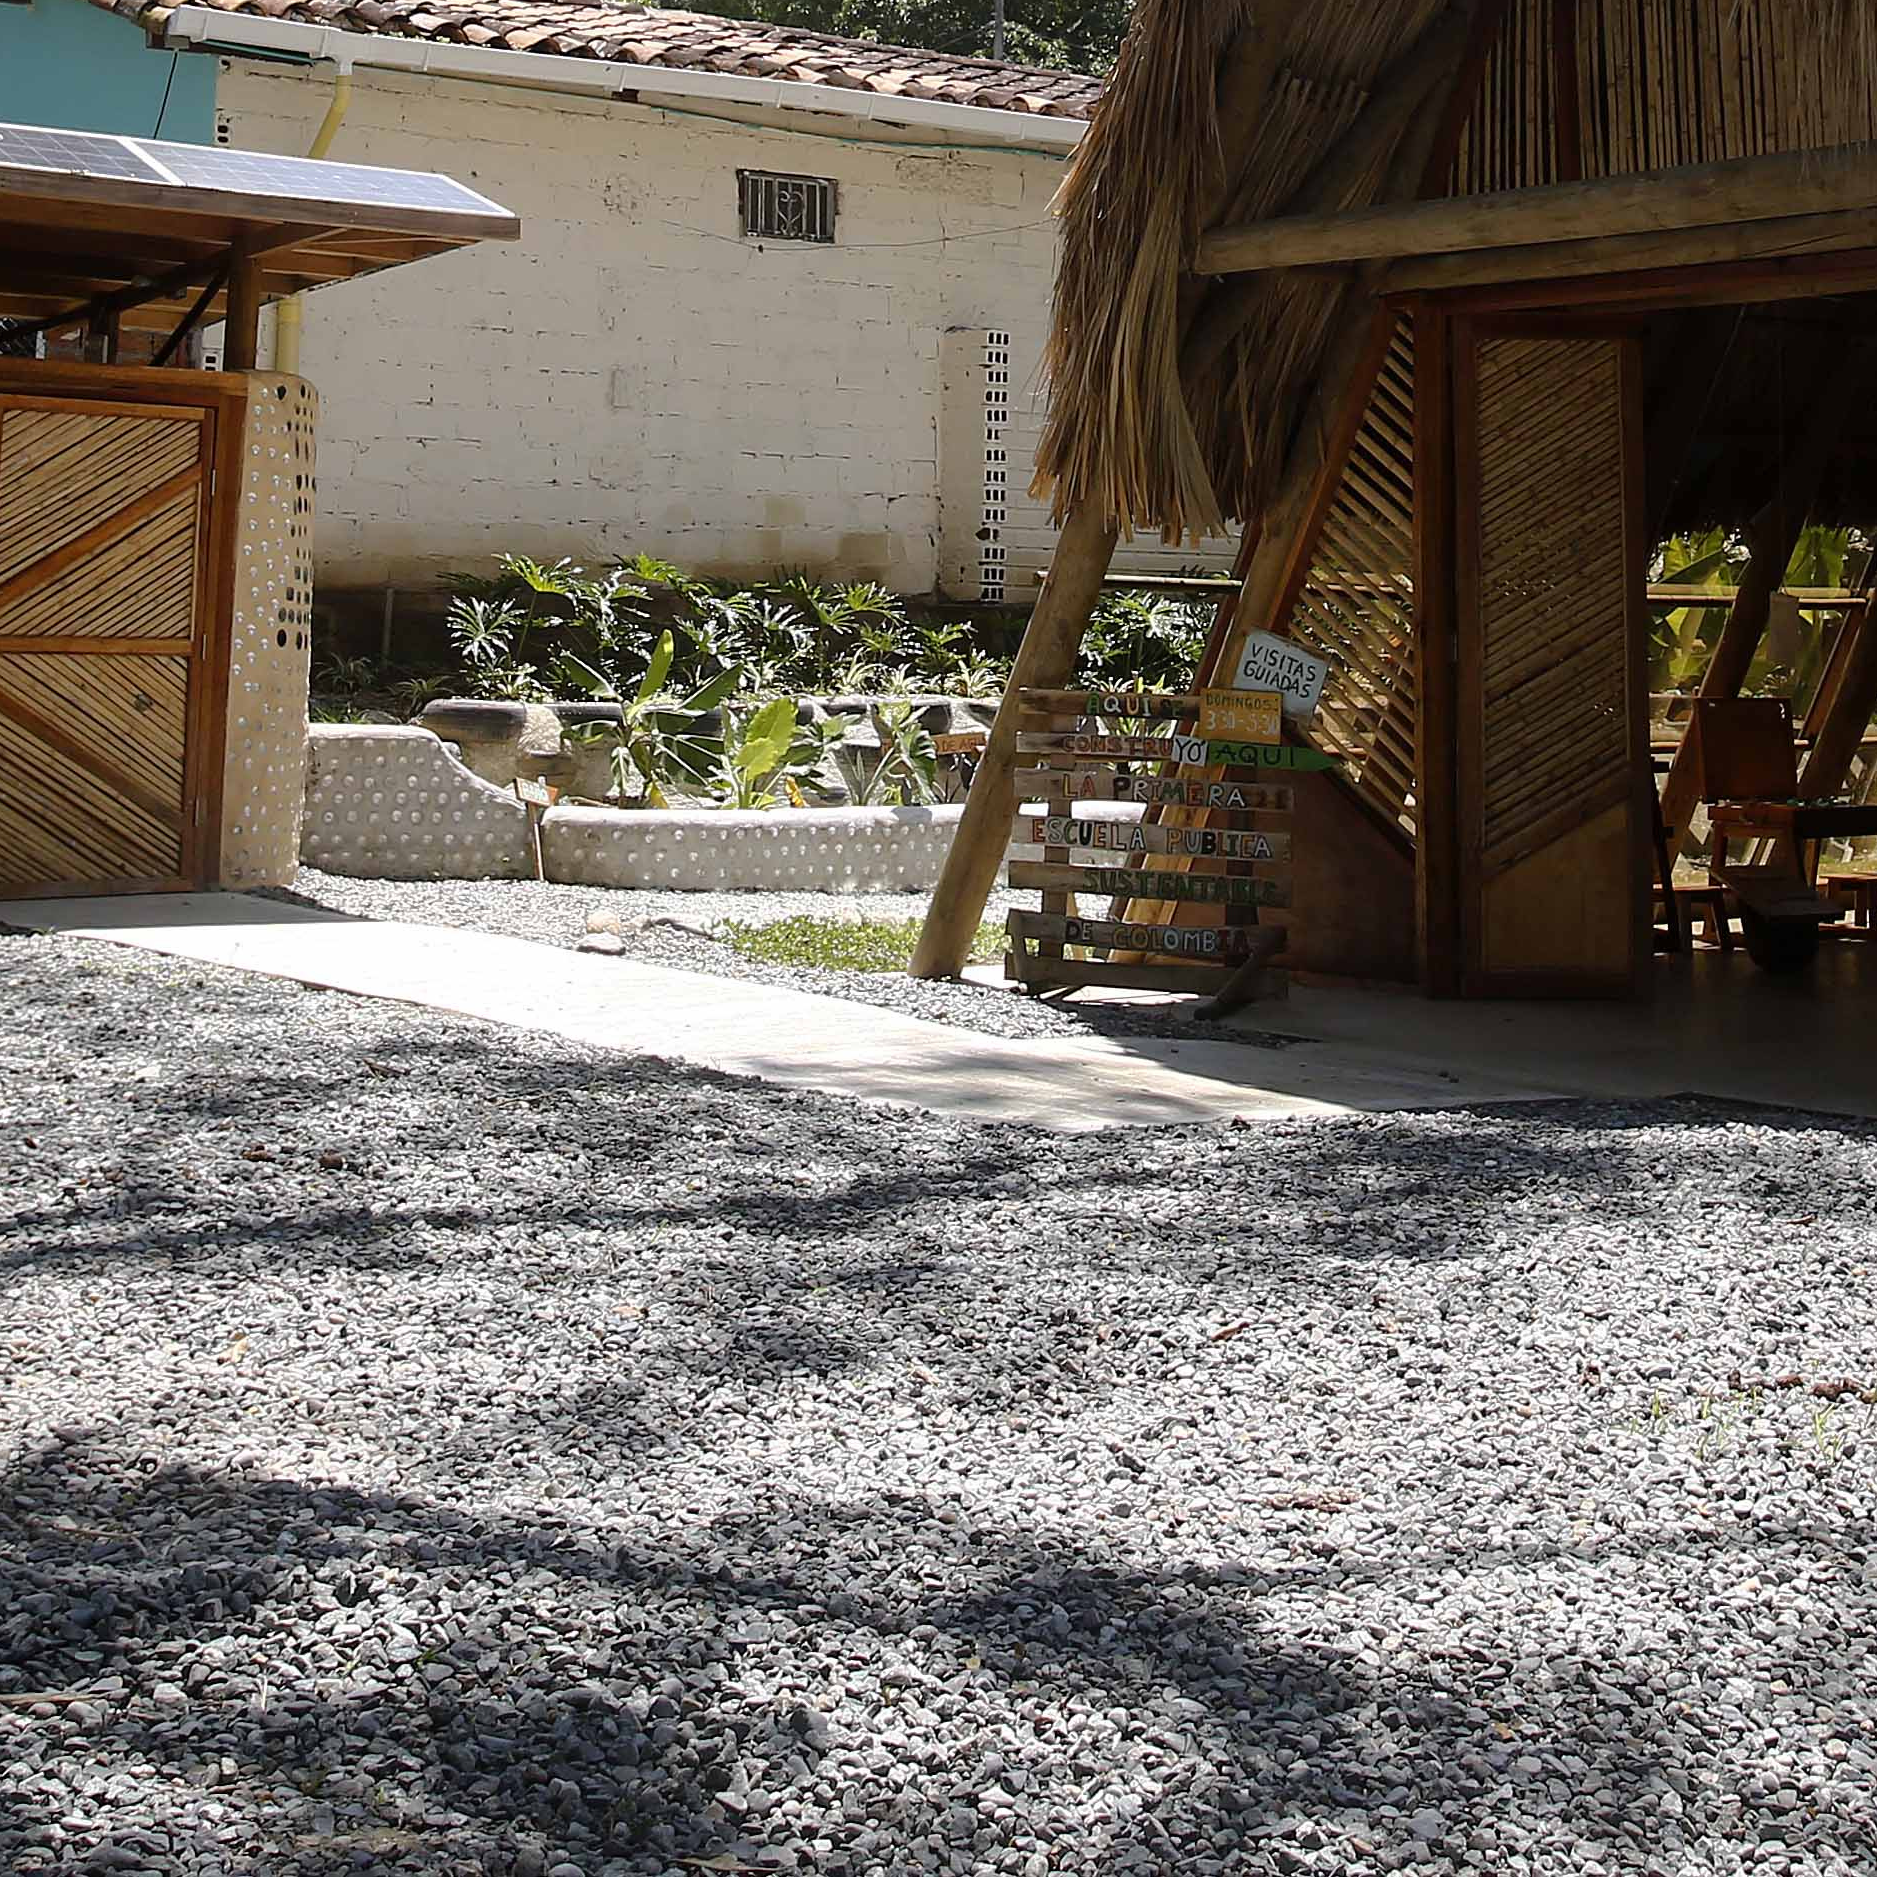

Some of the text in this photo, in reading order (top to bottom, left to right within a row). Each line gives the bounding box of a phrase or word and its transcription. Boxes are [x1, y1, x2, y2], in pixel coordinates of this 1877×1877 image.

[1243, 661, 1311, 699] GUIADAS
[1251, 642, 1316, 682] VISITAS
[1086, 692, 1152, 717] AQUI
[1214, 745, 1295, 766] AQUI
[1062, 774, 1096, 798] LA
[1113, 778, 1246, 809] PRIMERA
[1031, 818, 1147, 850] ESCUELA
[1166, 827, 1272, 858] PUBLICA
[1082, 869, 1278, 906] SUSTENTABLE
[1066, 922, 1250, 954] DE COLOMBIA
